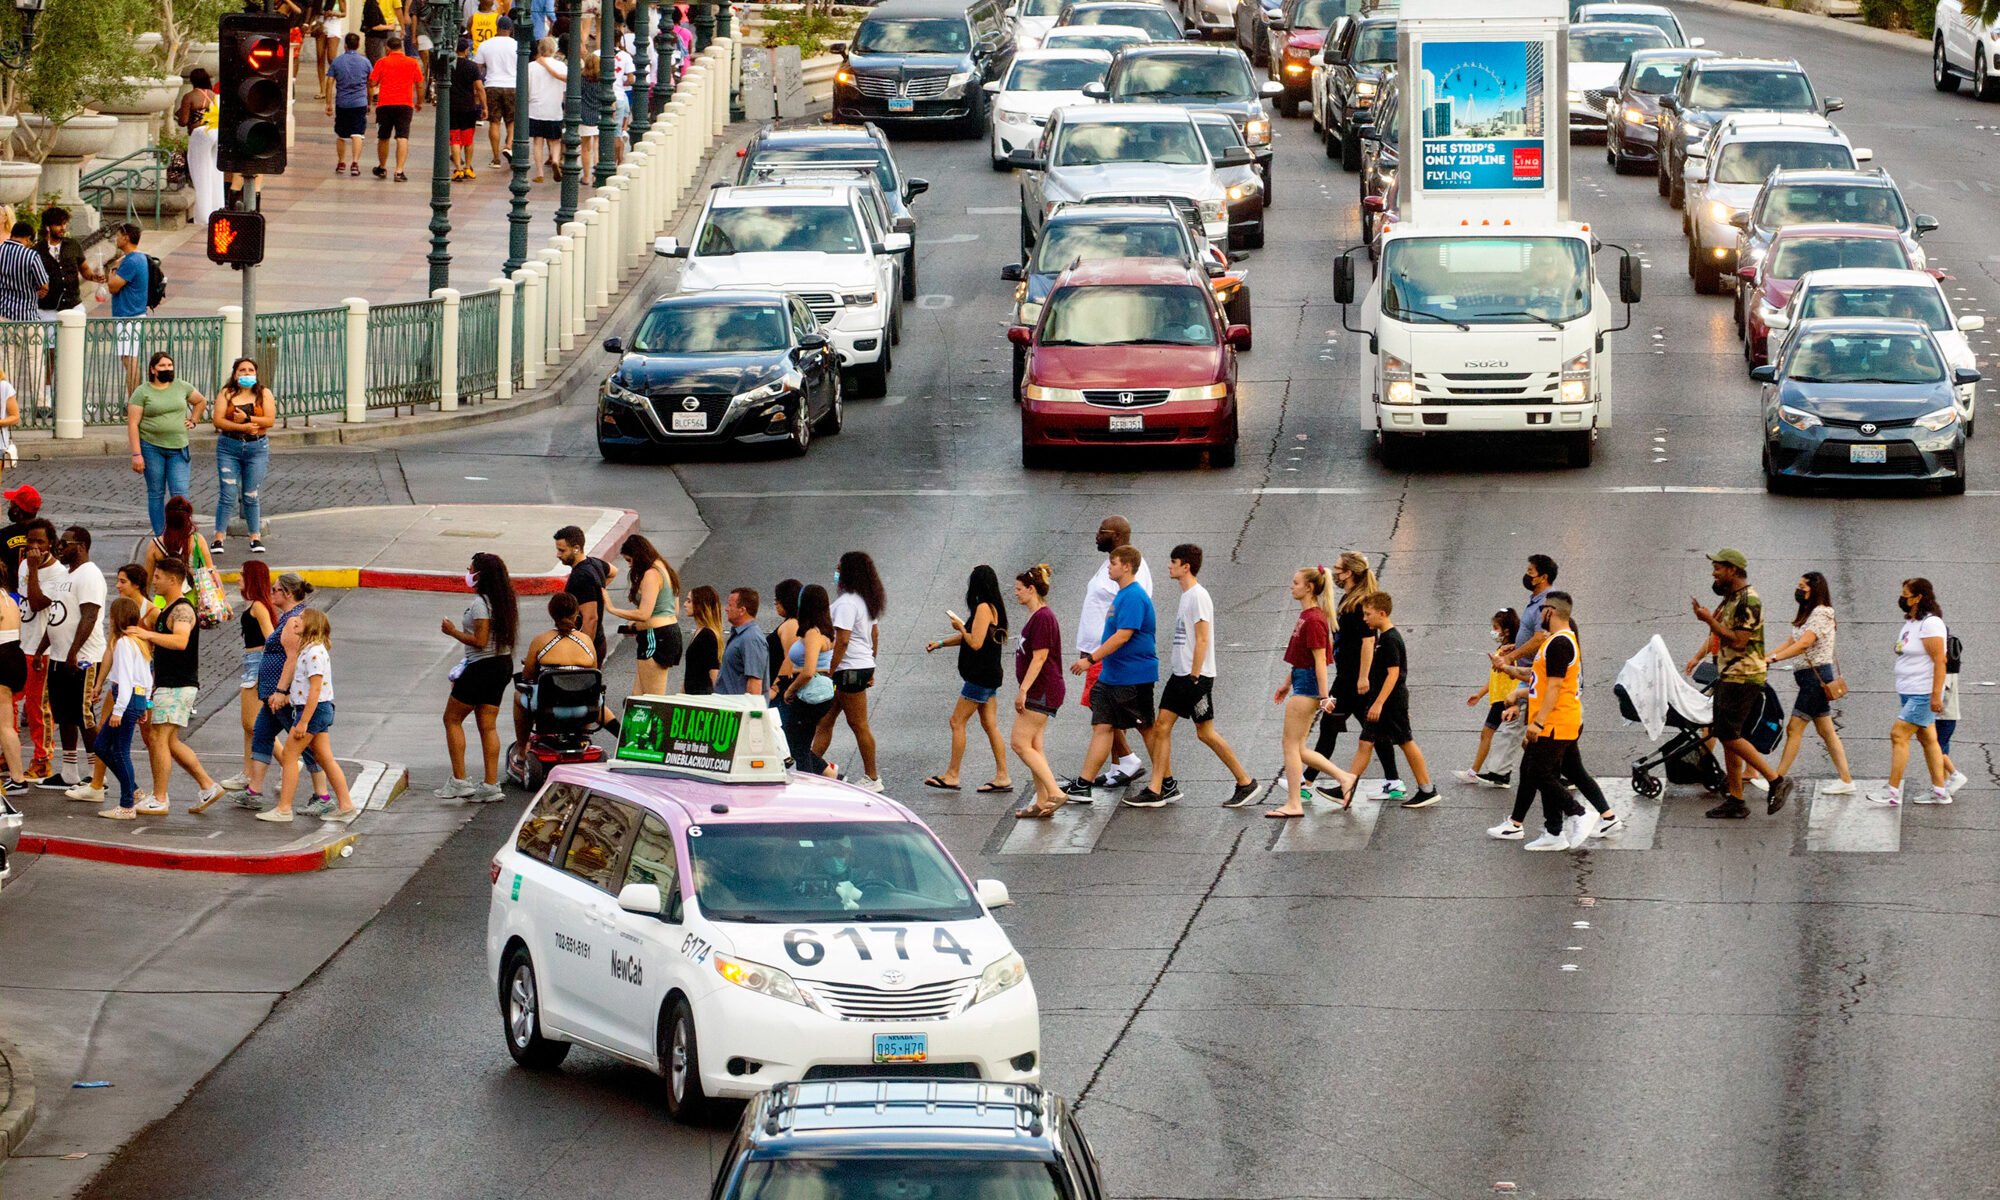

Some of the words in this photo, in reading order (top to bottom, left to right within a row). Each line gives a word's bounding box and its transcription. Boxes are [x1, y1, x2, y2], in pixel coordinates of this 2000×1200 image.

[475, 28, 493, 43] 30
[1425, 144, 1447, 154] THE
[1450, 143, 1496, 154] STRIP'S
[1425, 155, 1456, 165] ONLY
[1459, 155, 1506, 165] ZIPLINE
[1427, 171, 1472, 181] FLYLINQ
[665, 752, 731, 772] DINEBLACKOUT.COM
[688, 825, 703, 837] 6
[555, 932, 591, 959] 702-551-5151
[681, 932, 712, 964] 6174
[783, 927, 974, 967] 6174
[610, 949, 643, 986] NewCab
